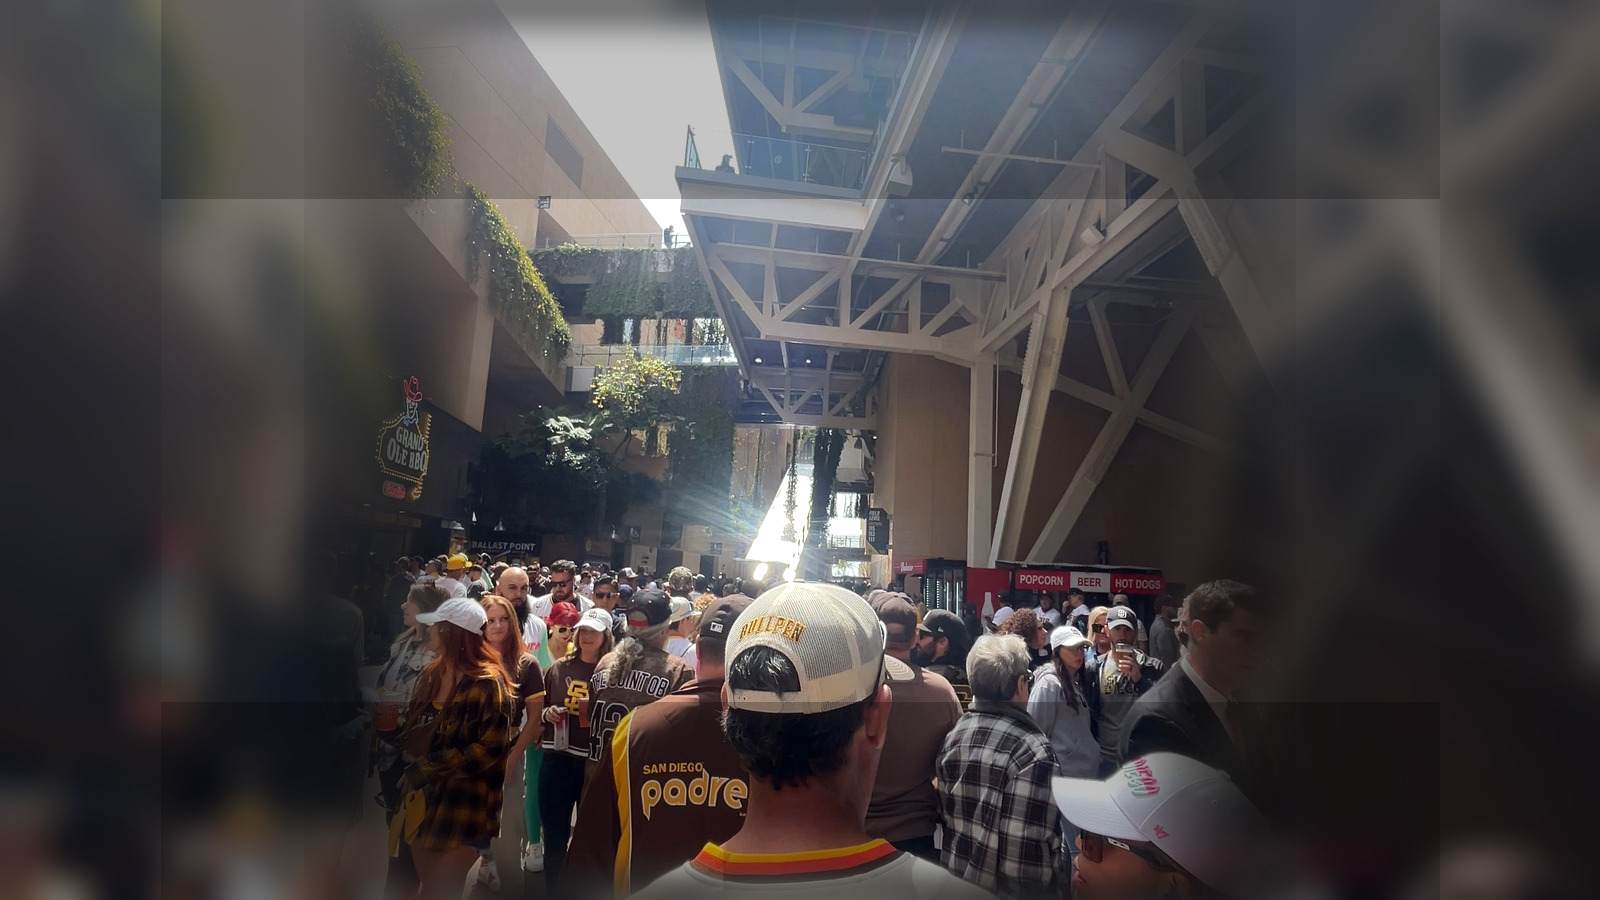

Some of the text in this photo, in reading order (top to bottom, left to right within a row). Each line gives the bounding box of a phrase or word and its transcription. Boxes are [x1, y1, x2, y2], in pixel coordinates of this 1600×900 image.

[396, 426, 424, 452] GRAND
[387, 438, 428, 472] OLE BBQ
[509, 542, 536, 551] POINT
[1019, 574, 1161, 590] POPCORN BEER HOT DOGS
[739, 615, 806, 642] BULLPEN
[642, 762, 704, 775] SAN DIEGO
